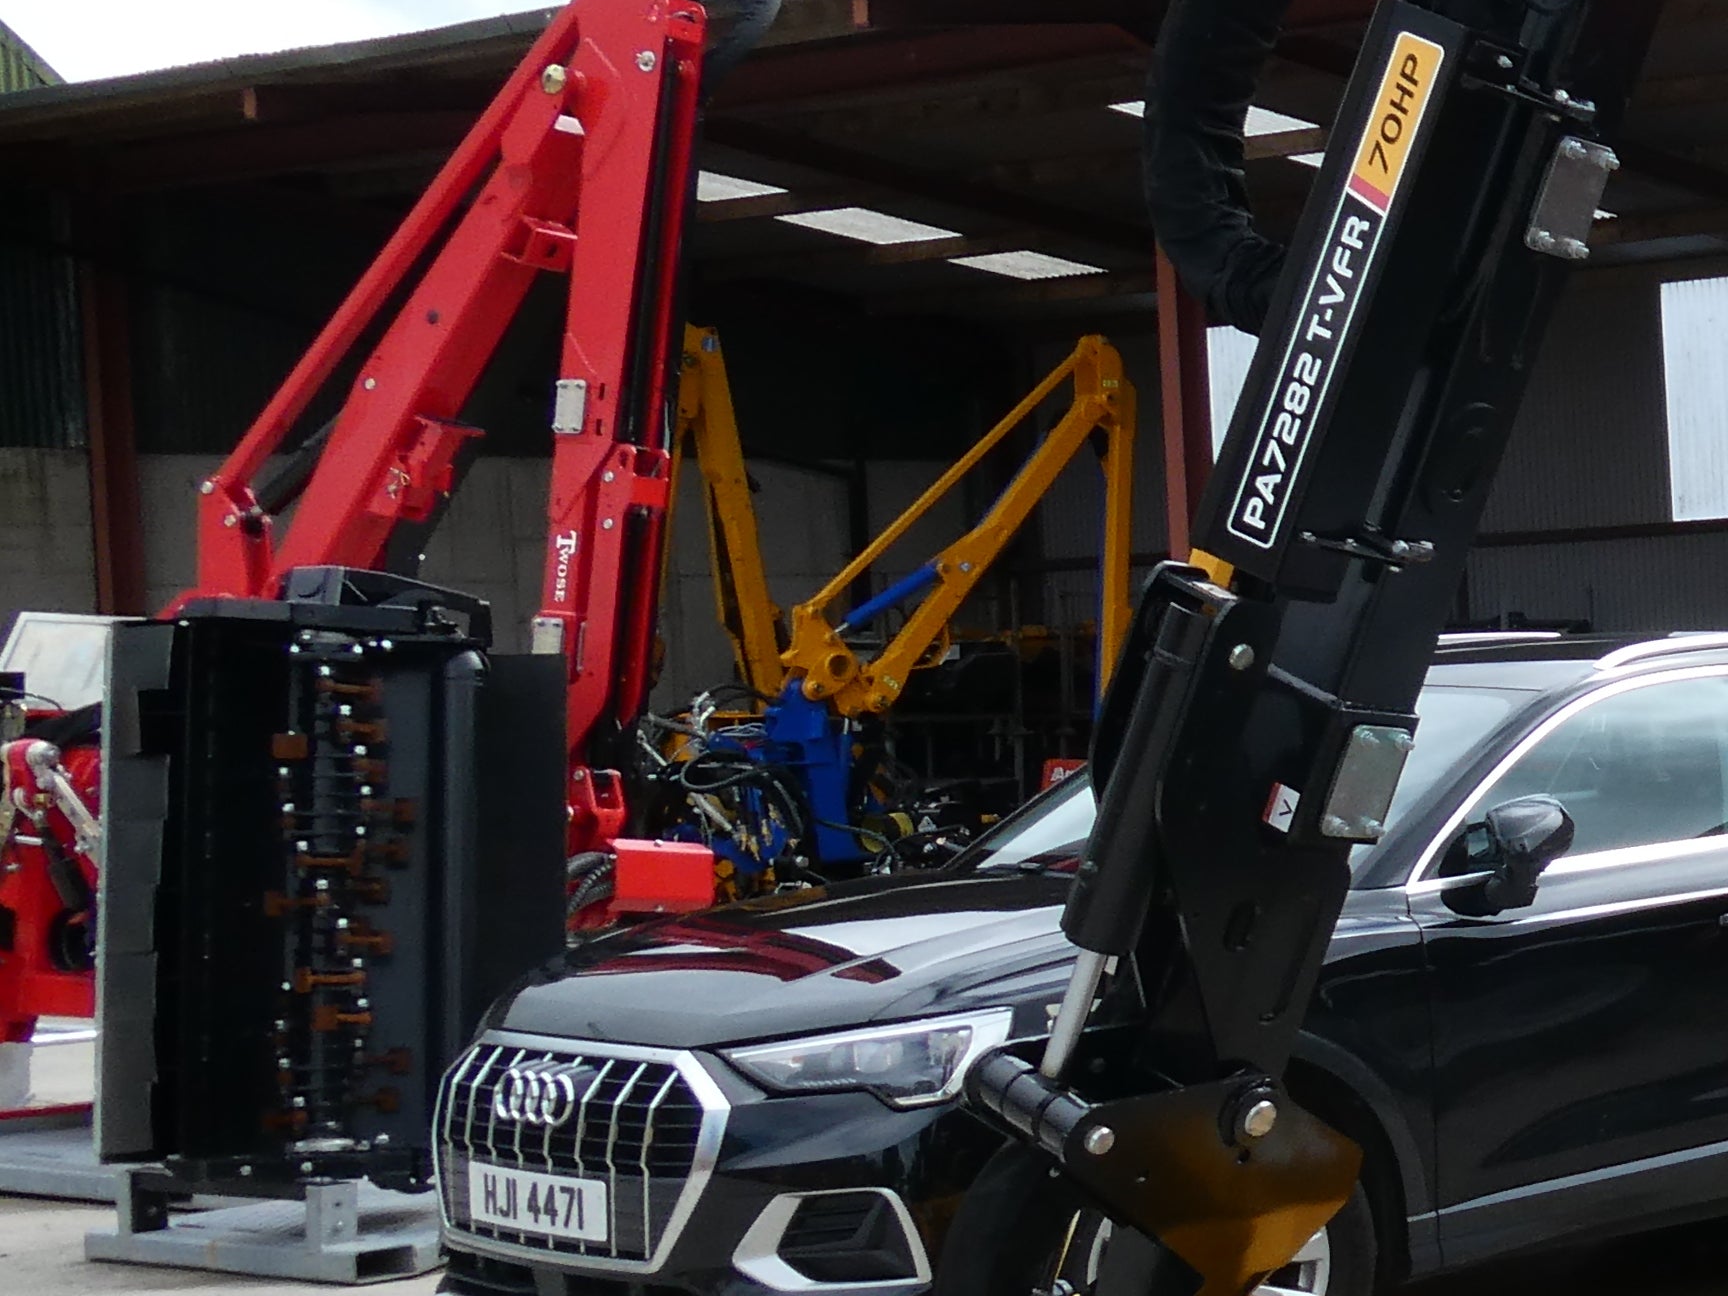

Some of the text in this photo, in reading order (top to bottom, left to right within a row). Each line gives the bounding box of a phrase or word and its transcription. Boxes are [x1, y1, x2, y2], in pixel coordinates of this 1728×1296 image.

[1243, 52, 1420, 531] PA7282 T-VFR 70HP
[484, 1172, 584, 1231] HJI 4471
